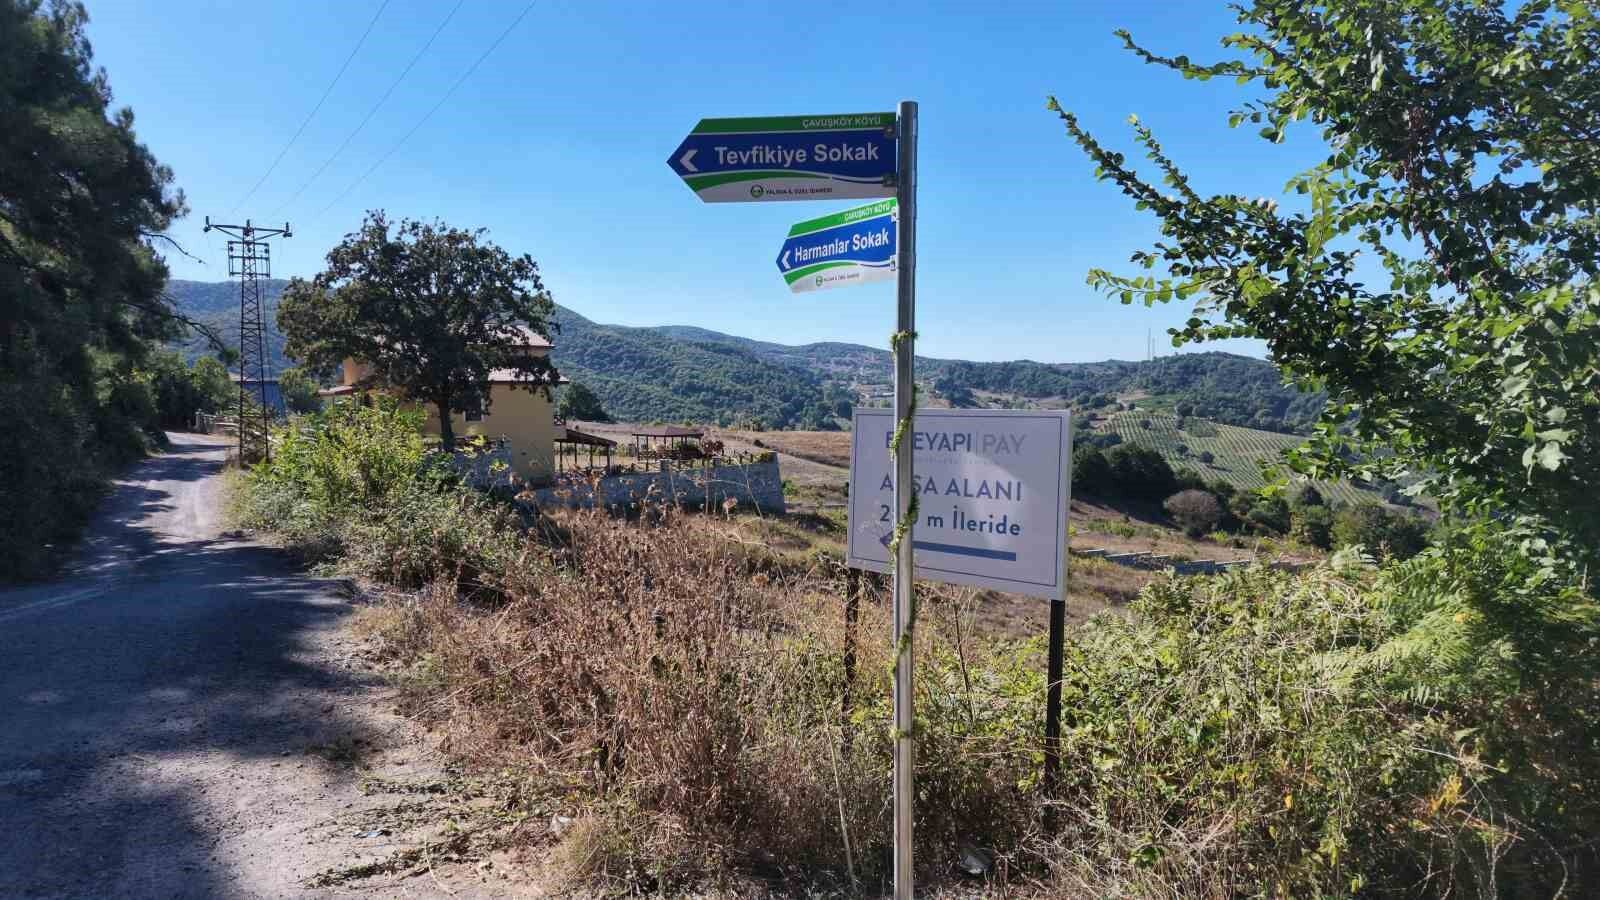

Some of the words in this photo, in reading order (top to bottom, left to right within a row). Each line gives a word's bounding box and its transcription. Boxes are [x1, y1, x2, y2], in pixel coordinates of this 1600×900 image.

[802, 118, 851, 128] ÇAVUŞKÖY
[855, 116, 881, 126] KÖYÜ
[714, 143, 807, 168] Tevfikiye
[814, 142, 879, 162] Sokak
[795, 238, 850, 263] Harmanlar
[852, 227, 889, 251] Sokak
[886, 431, 971, 451] EEYAPI
[983, 434, 1026, 454] PAY
[880, 474, 938, 495] ASA
[944, 478, 1022, 501] ALANI
[927, 514, 944, 529] m
[953, 505, 1021, 536] İleride
